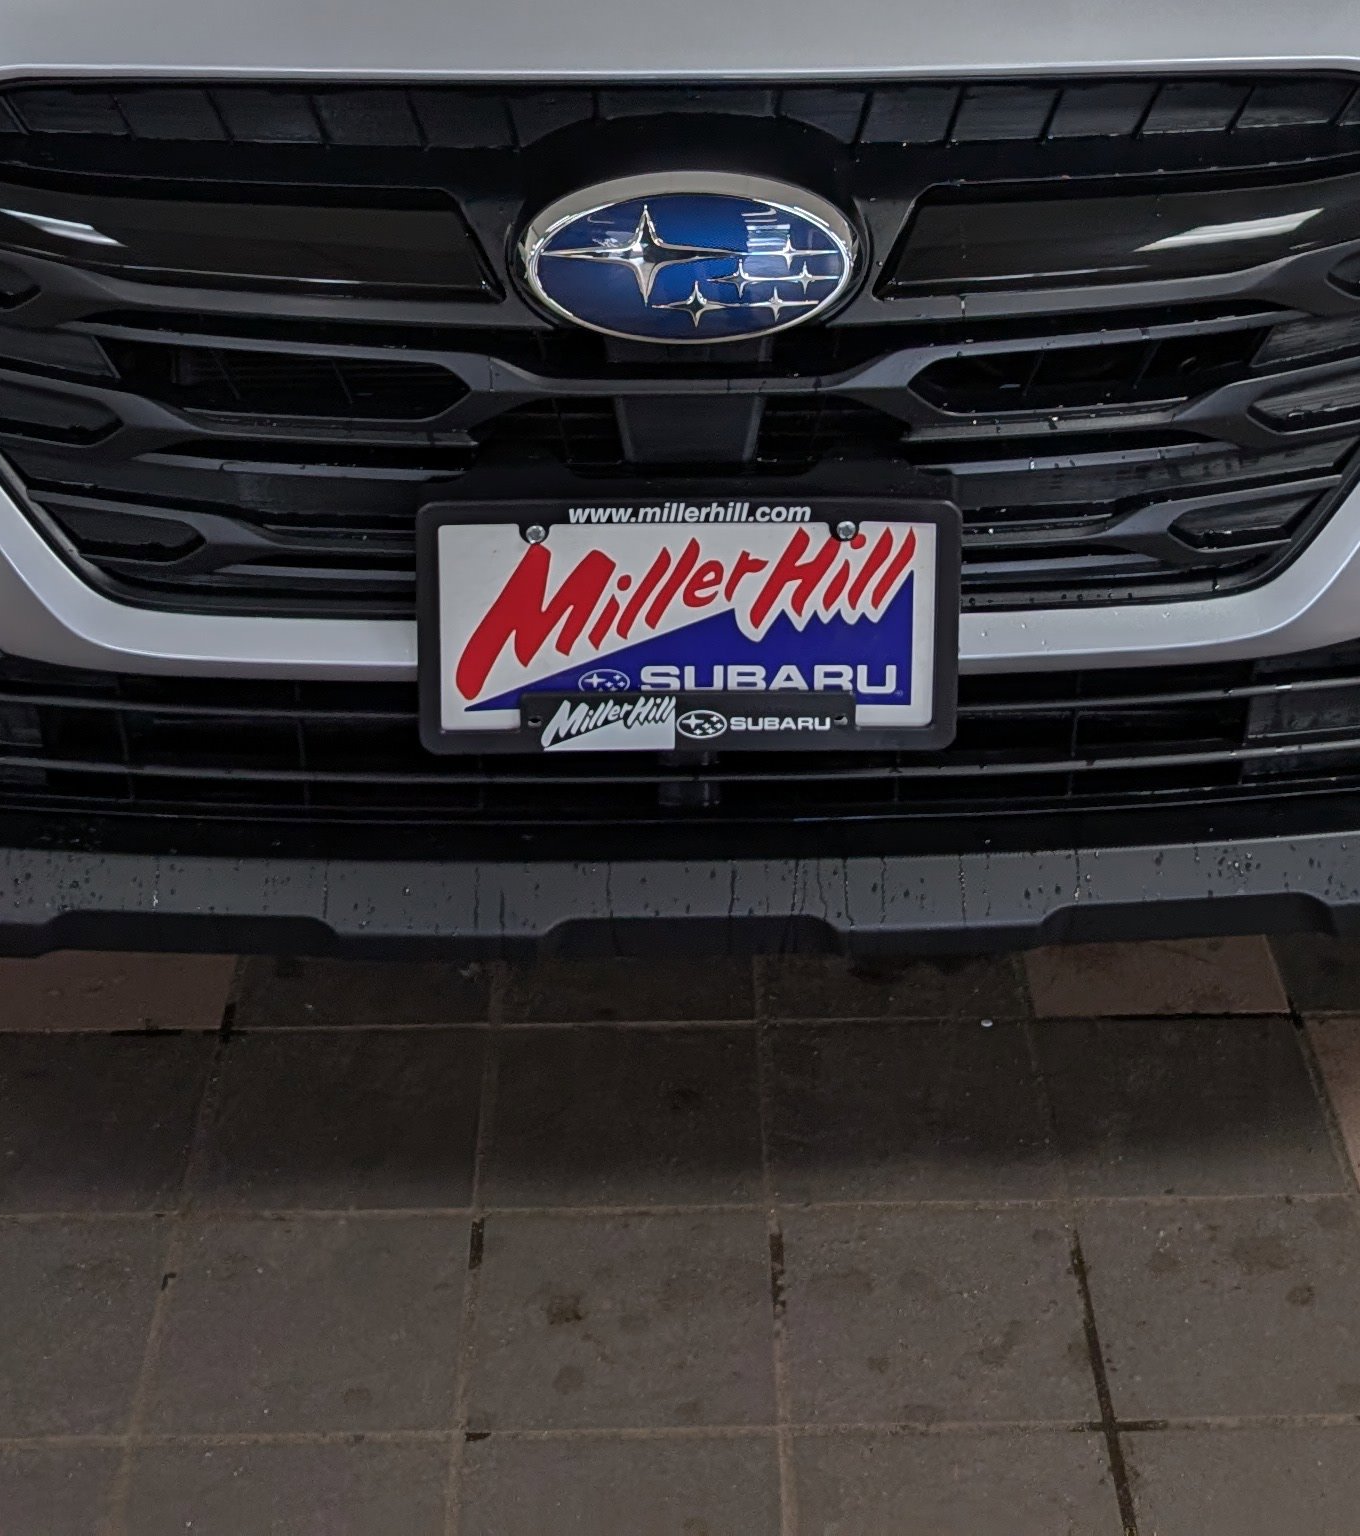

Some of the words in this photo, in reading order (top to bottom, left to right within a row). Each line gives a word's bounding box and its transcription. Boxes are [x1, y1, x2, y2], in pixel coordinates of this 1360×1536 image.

[568, 501, 811, 524] www.millerhill.com
[640, 664, 897, 694] SUBARU
[729, 716, 831, 731] SUBARU
